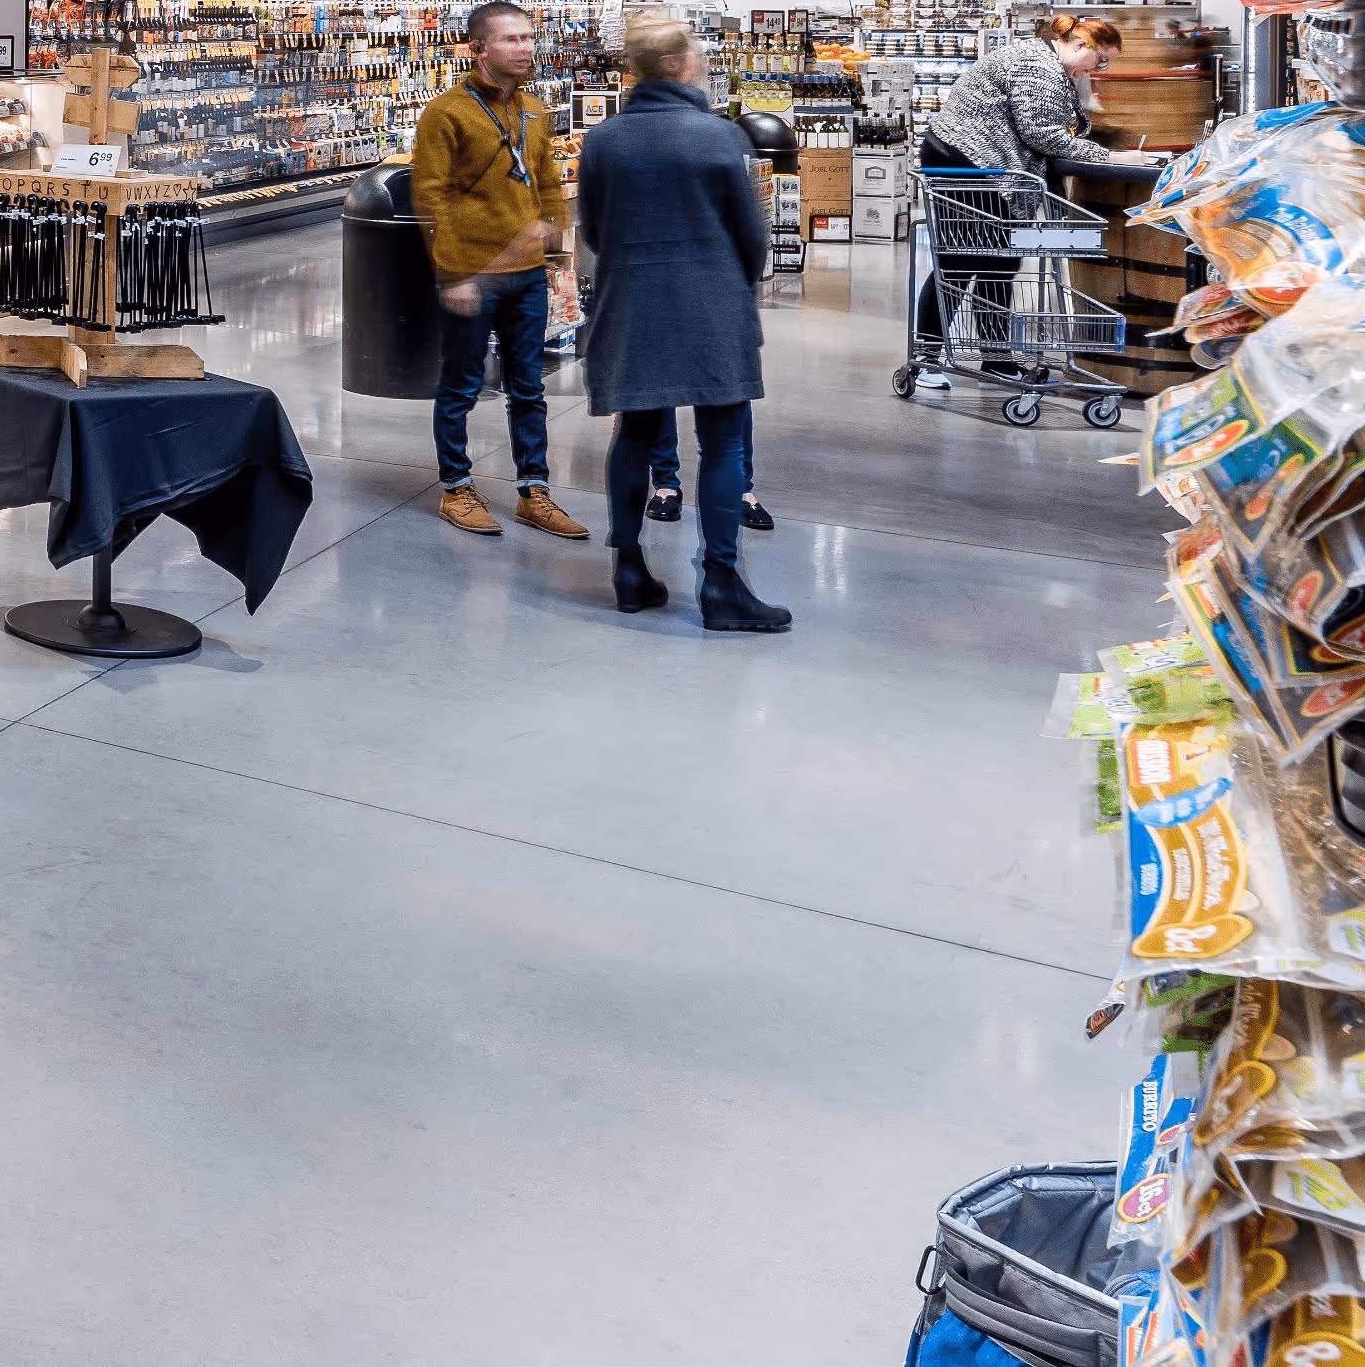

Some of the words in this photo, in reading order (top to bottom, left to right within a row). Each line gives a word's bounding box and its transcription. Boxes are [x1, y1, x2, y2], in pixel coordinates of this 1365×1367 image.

[585, 105, 604, 113] ACE
[809, 164, 828, 173] JOEL
[828, 164, 850, 173] GOTT
[1141, 1080, 1158, 1132] BURRITO
